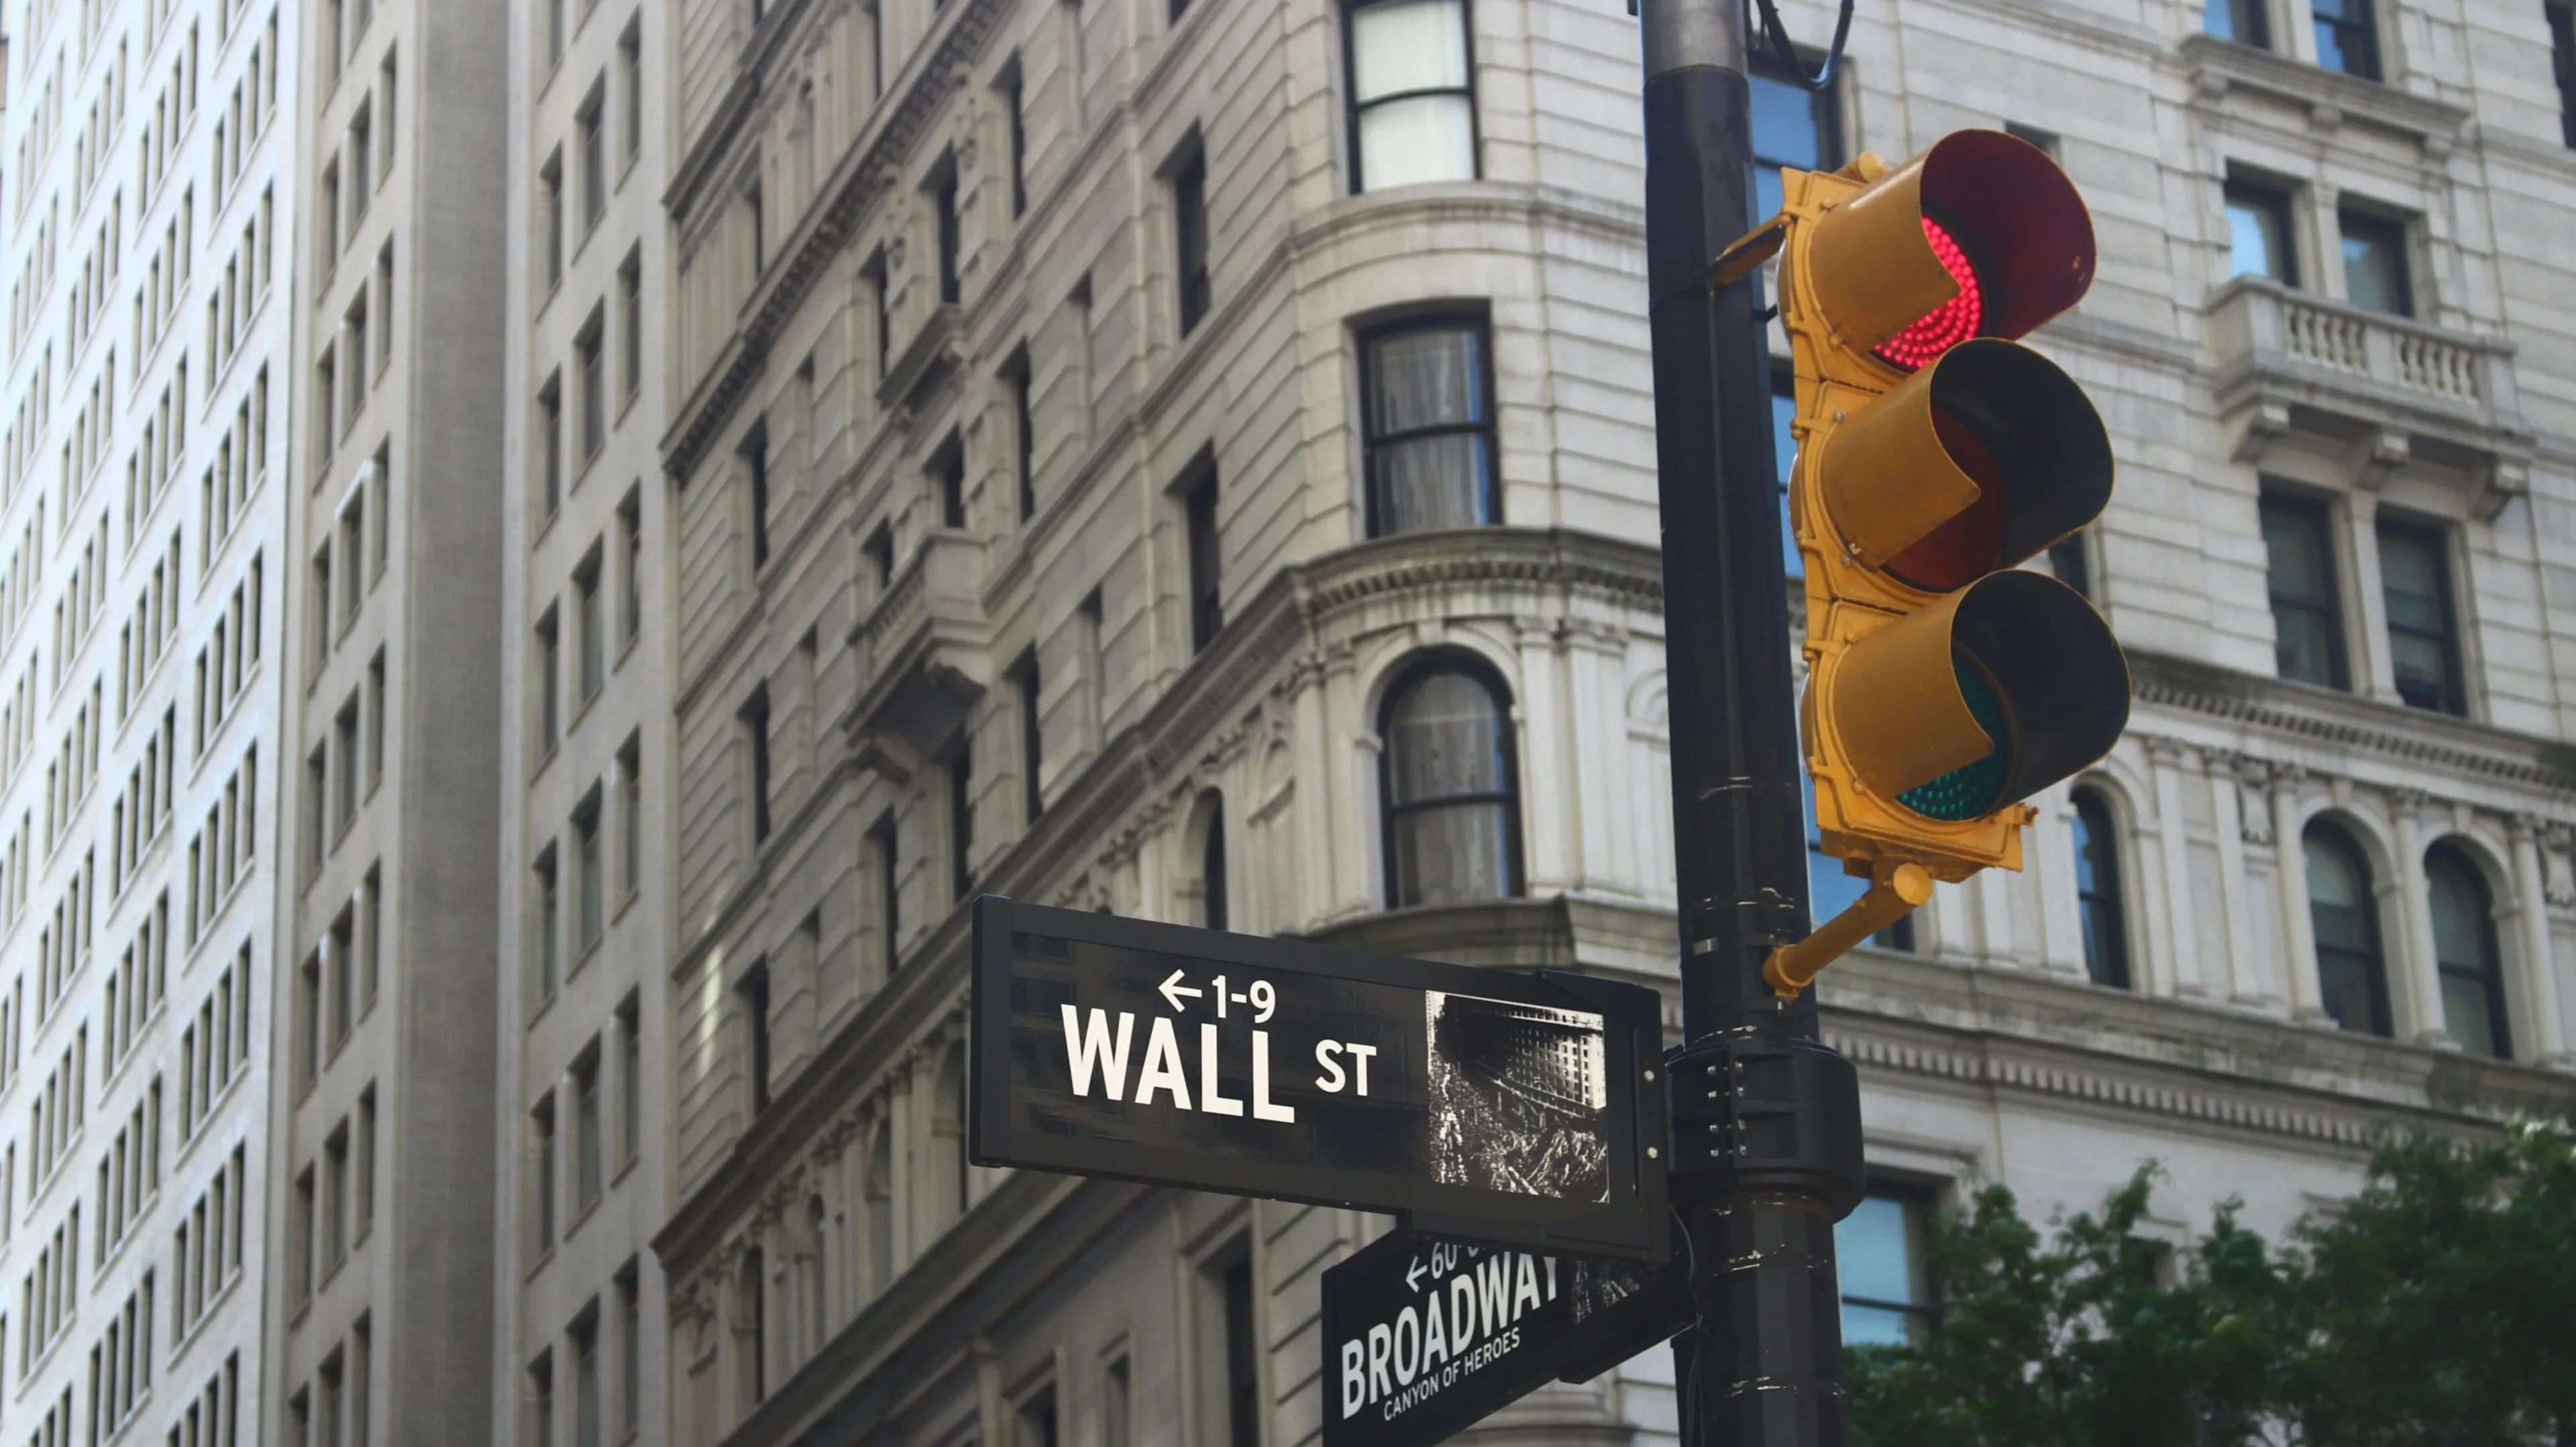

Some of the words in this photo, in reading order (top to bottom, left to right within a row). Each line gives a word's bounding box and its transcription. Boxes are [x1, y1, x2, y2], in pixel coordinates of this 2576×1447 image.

[1212, 975, 1276, 1024] 1-9
[1061, 1004, 1295, 1124] WALL
[1315, 1039, 1377, 1096] ST
[1384, 1373, 1439, 1422] CANYON
[1443, 1360, 1460, 1388] OF
[1464, 1327, 1521, 1376] HEROES
